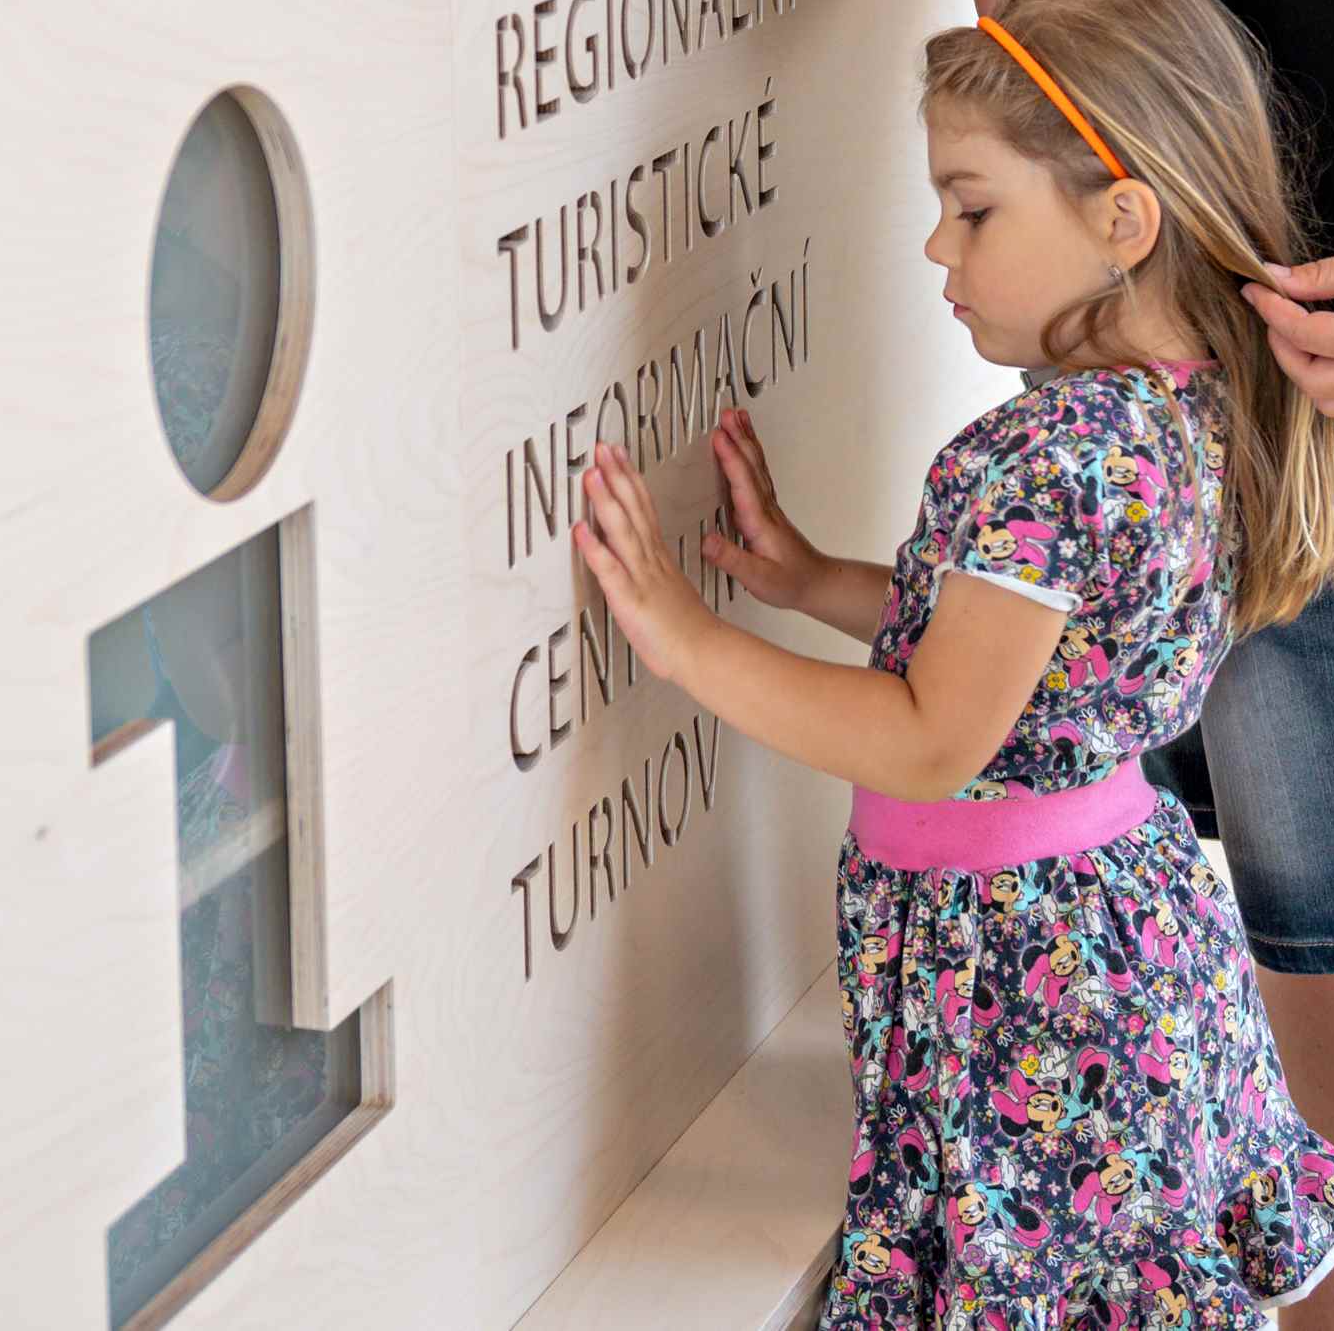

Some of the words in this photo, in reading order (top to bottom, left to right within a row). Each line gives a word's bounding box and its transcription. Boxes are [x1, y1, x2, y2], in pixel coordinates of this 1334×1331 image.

[497, 75, 781, 352] TURISTICKÉ
[505, 236, 811, 570] INFORMAČNÍ
[510, 712, 723, 983] TURNOV
